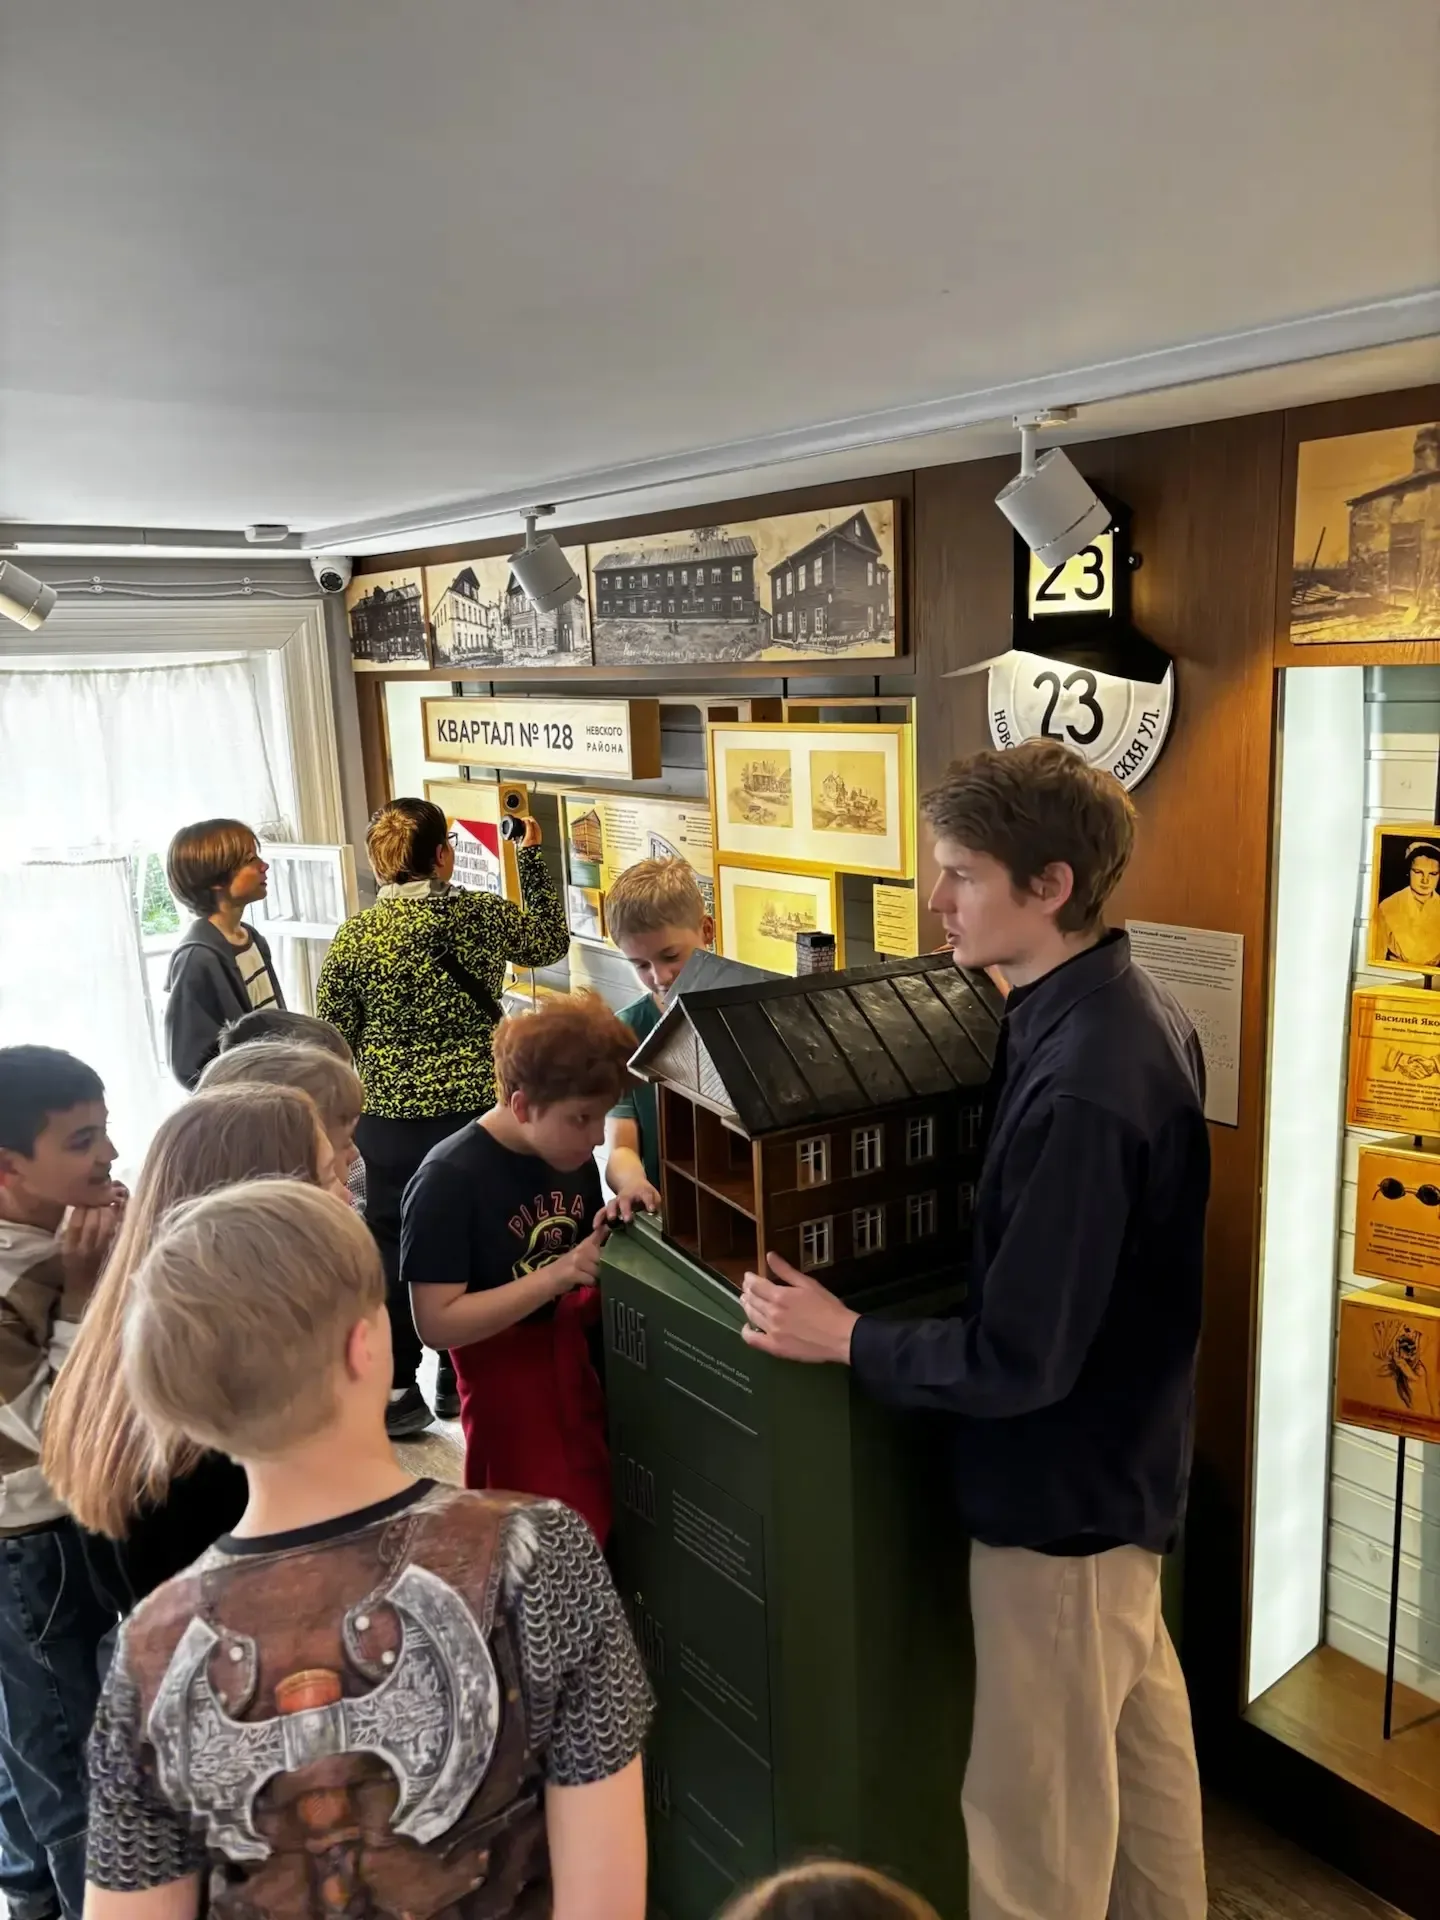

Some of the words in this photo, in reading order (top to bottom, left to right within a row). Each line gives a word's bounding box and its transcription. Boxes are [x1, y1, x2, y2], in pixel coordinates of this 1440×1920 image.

[1036, 545, 1105, 601] 23
[1033, 669, 1104, 745] 23
[437, 718, 514, 747] КВАРТАЛ
[520, 722, 540, 748] №
[543, 723, 574, 750] 128
[586, 725, 623, 737] НЕВСКОГО
[1137, 708, 1161, 740] УЛ.
[586, 741, 624, 754] РАЙОНА
[1375, 1013, 1418, 1025] Василий
[508, 1191, 585, 1240] PIZZA
